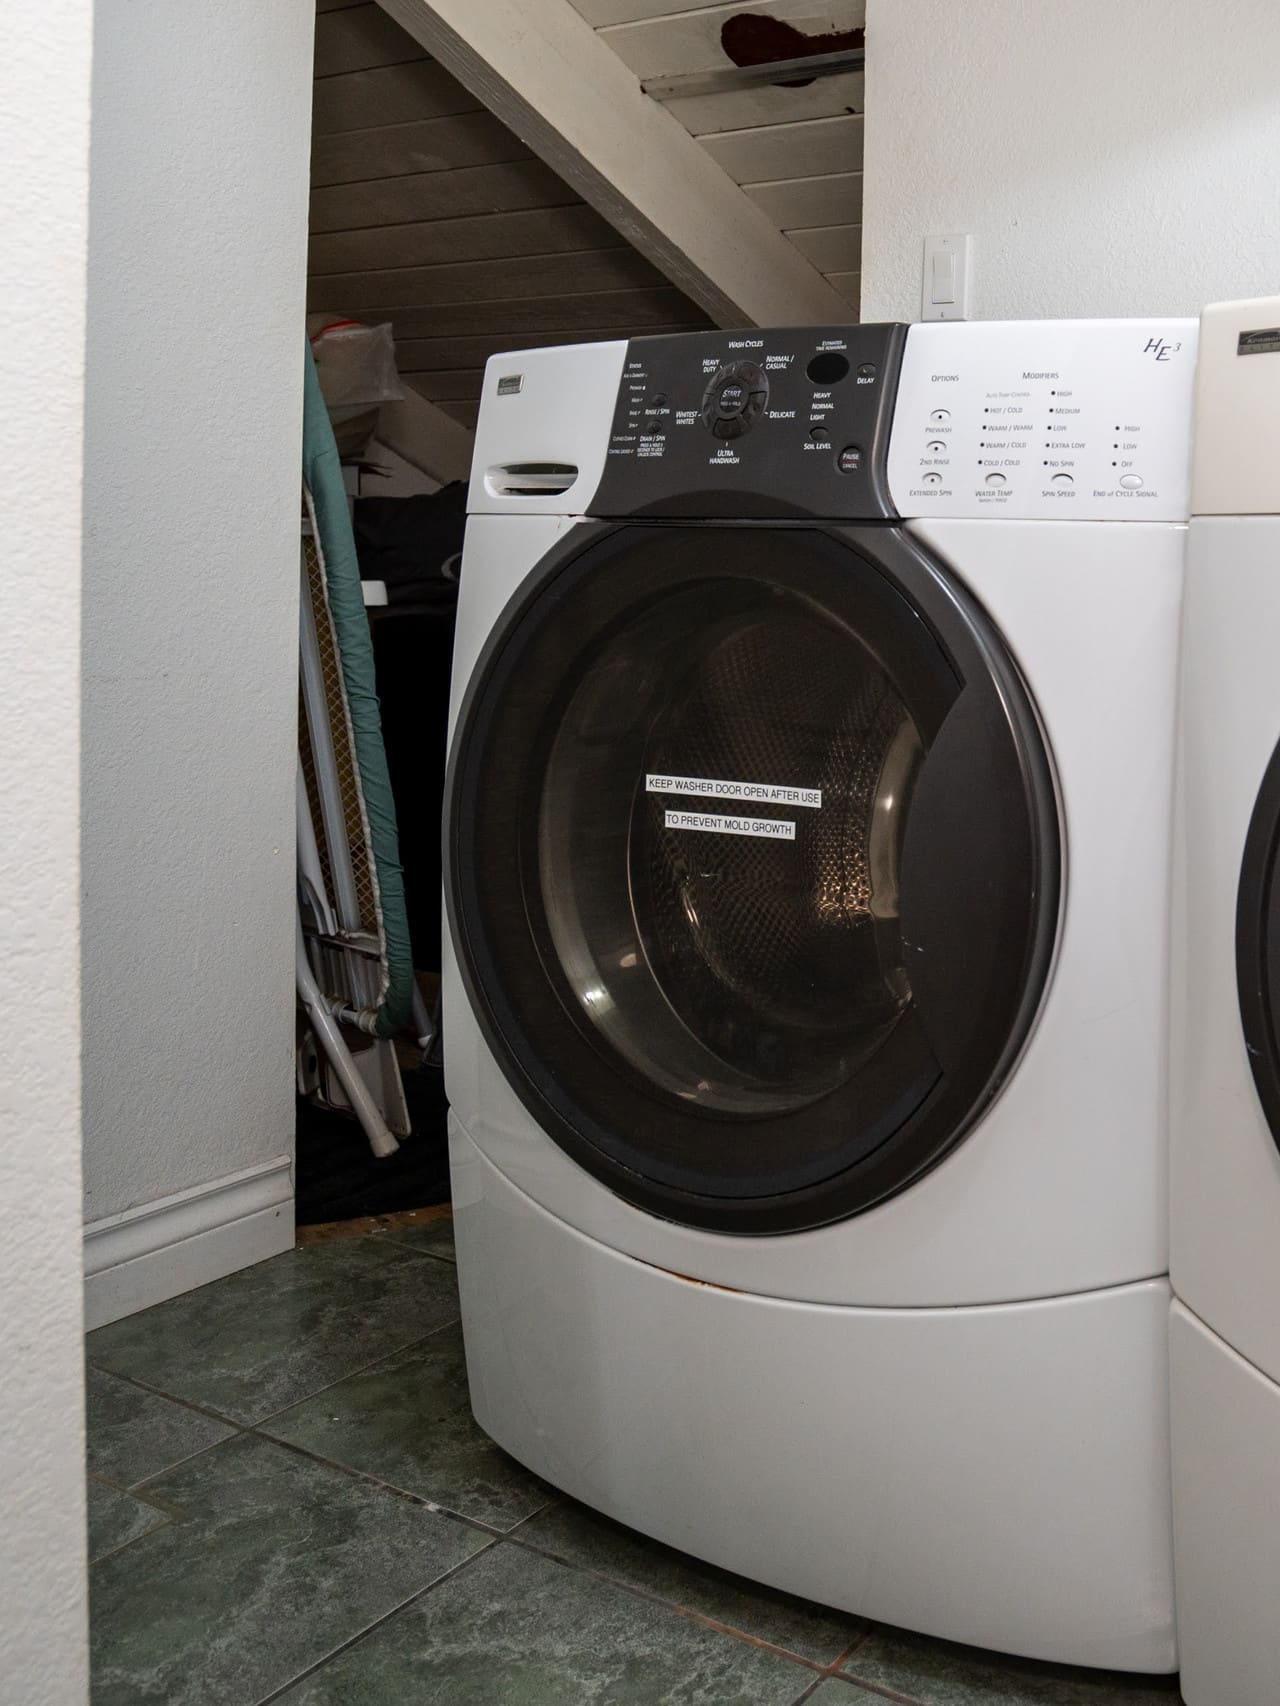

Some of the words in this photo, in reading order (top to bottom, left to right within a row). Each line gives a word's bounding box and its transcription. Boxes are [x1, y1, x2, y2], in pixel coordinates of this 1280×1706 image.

[1022, 372, 1060, 380] MODIFIERS
[649, 778, 673, 789] KEEP
[675, 780, 713, 792] WASHER
[715, 784, 742, 795] DOOR
[744, 786, 769, 798] OPEN
[771, 790, 799, 801] AFTER
[801, 792, 820, 804] USE
[667, 814, 679, 824] TO
[681, 815, 722, 828] PREVENT
[724, 820, 750, 831] MOLD
[752, 822, 792, 834] GROWTH
